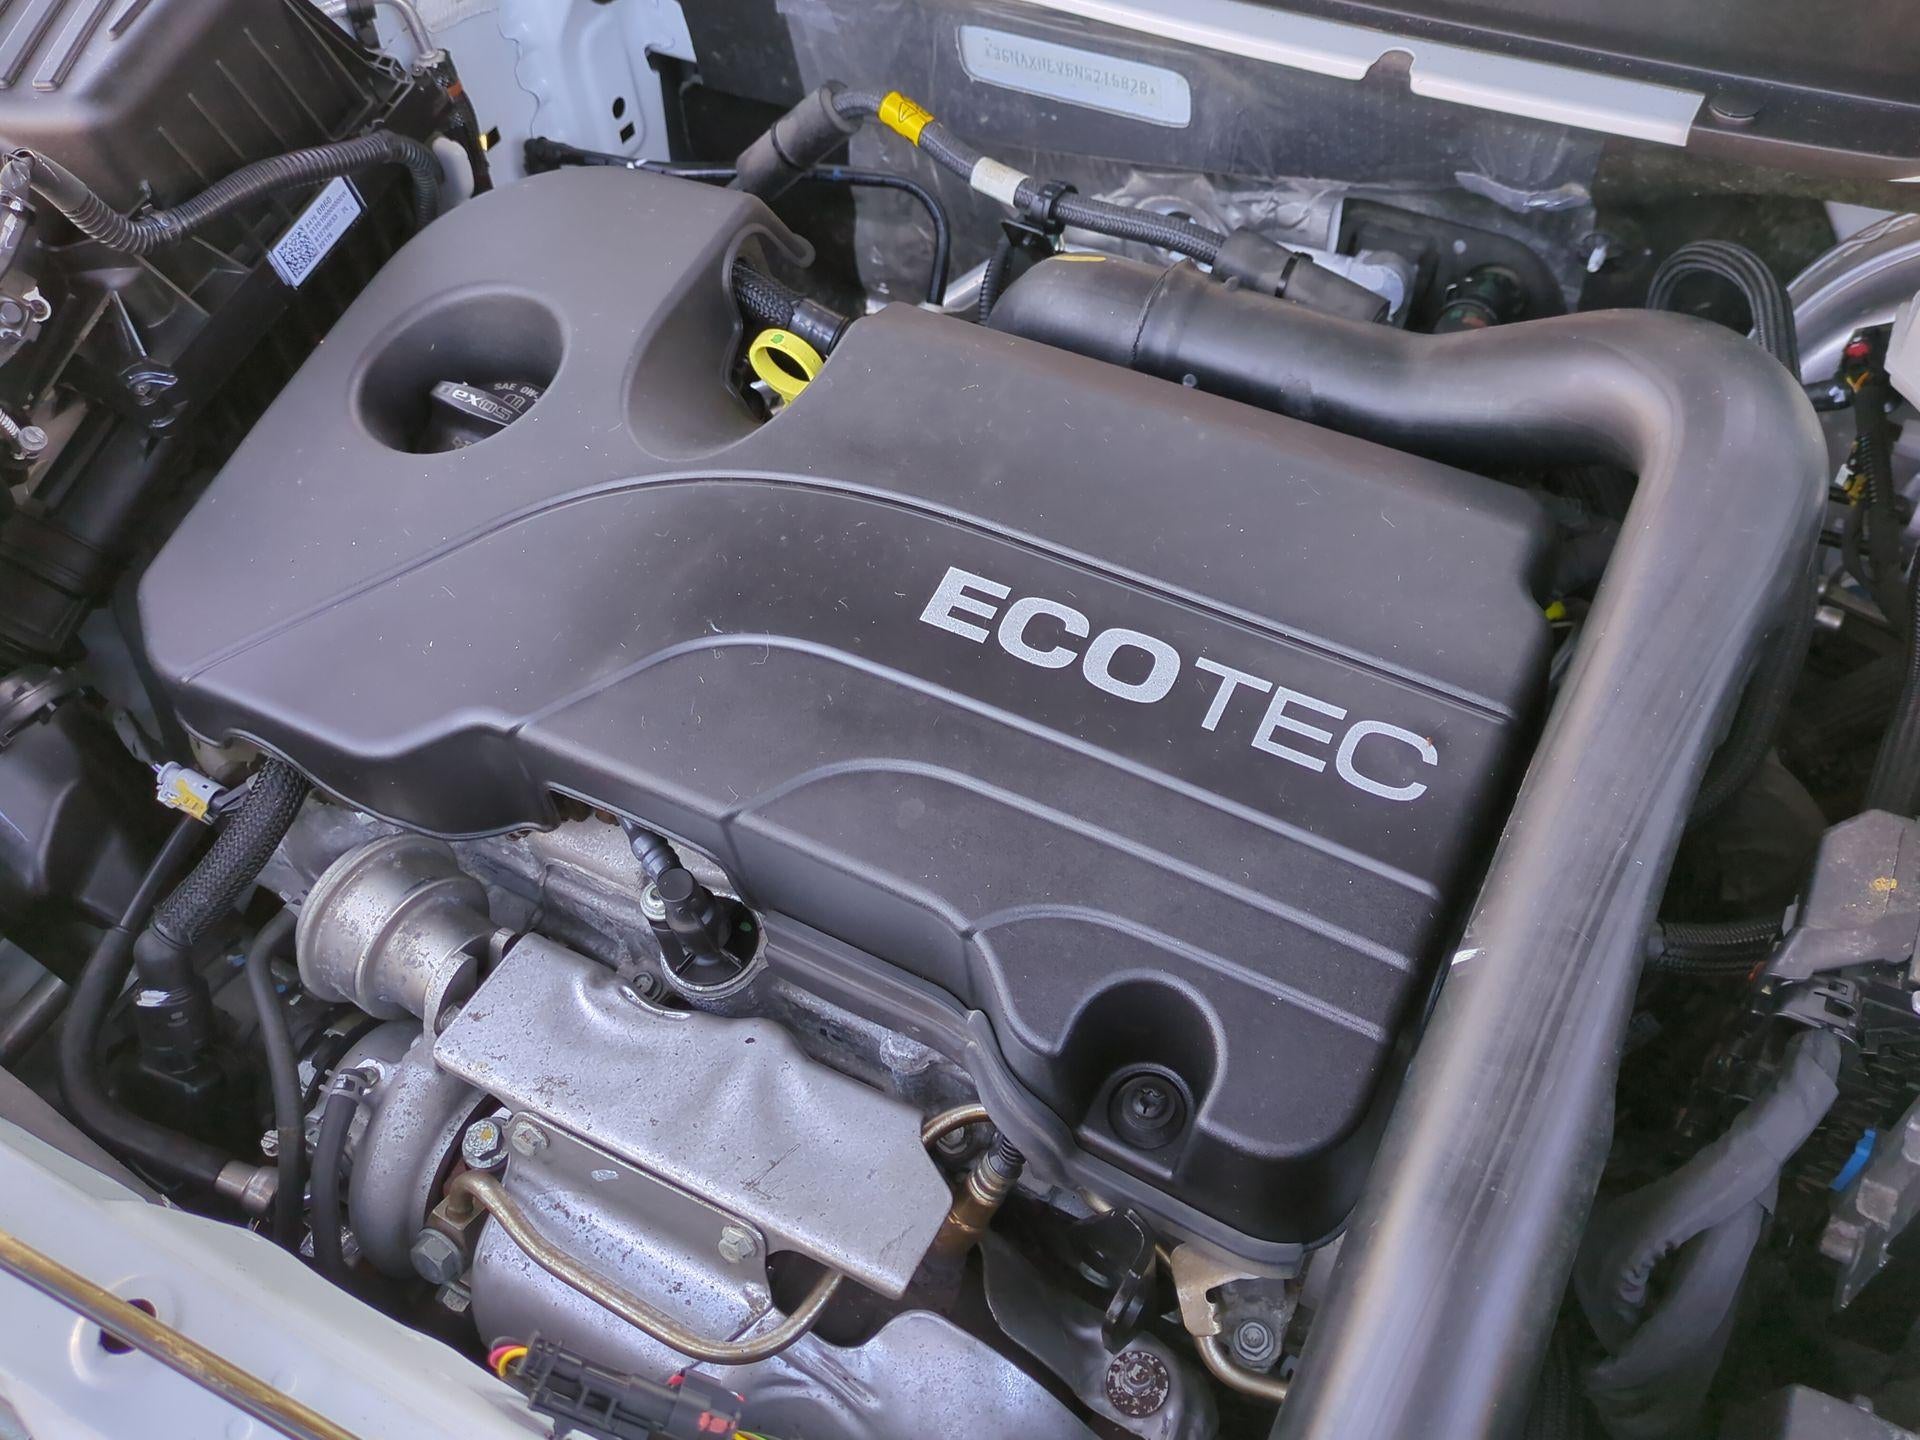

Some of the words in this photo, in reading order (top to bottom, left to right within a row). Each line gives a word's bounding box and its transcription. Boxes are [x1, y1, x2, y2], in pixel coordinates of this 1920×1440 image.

[493, 383, 517, 391] SAE
[520, 386, 540, 401] 0W-
[919, 566, 1438, 801] ECOTEC
